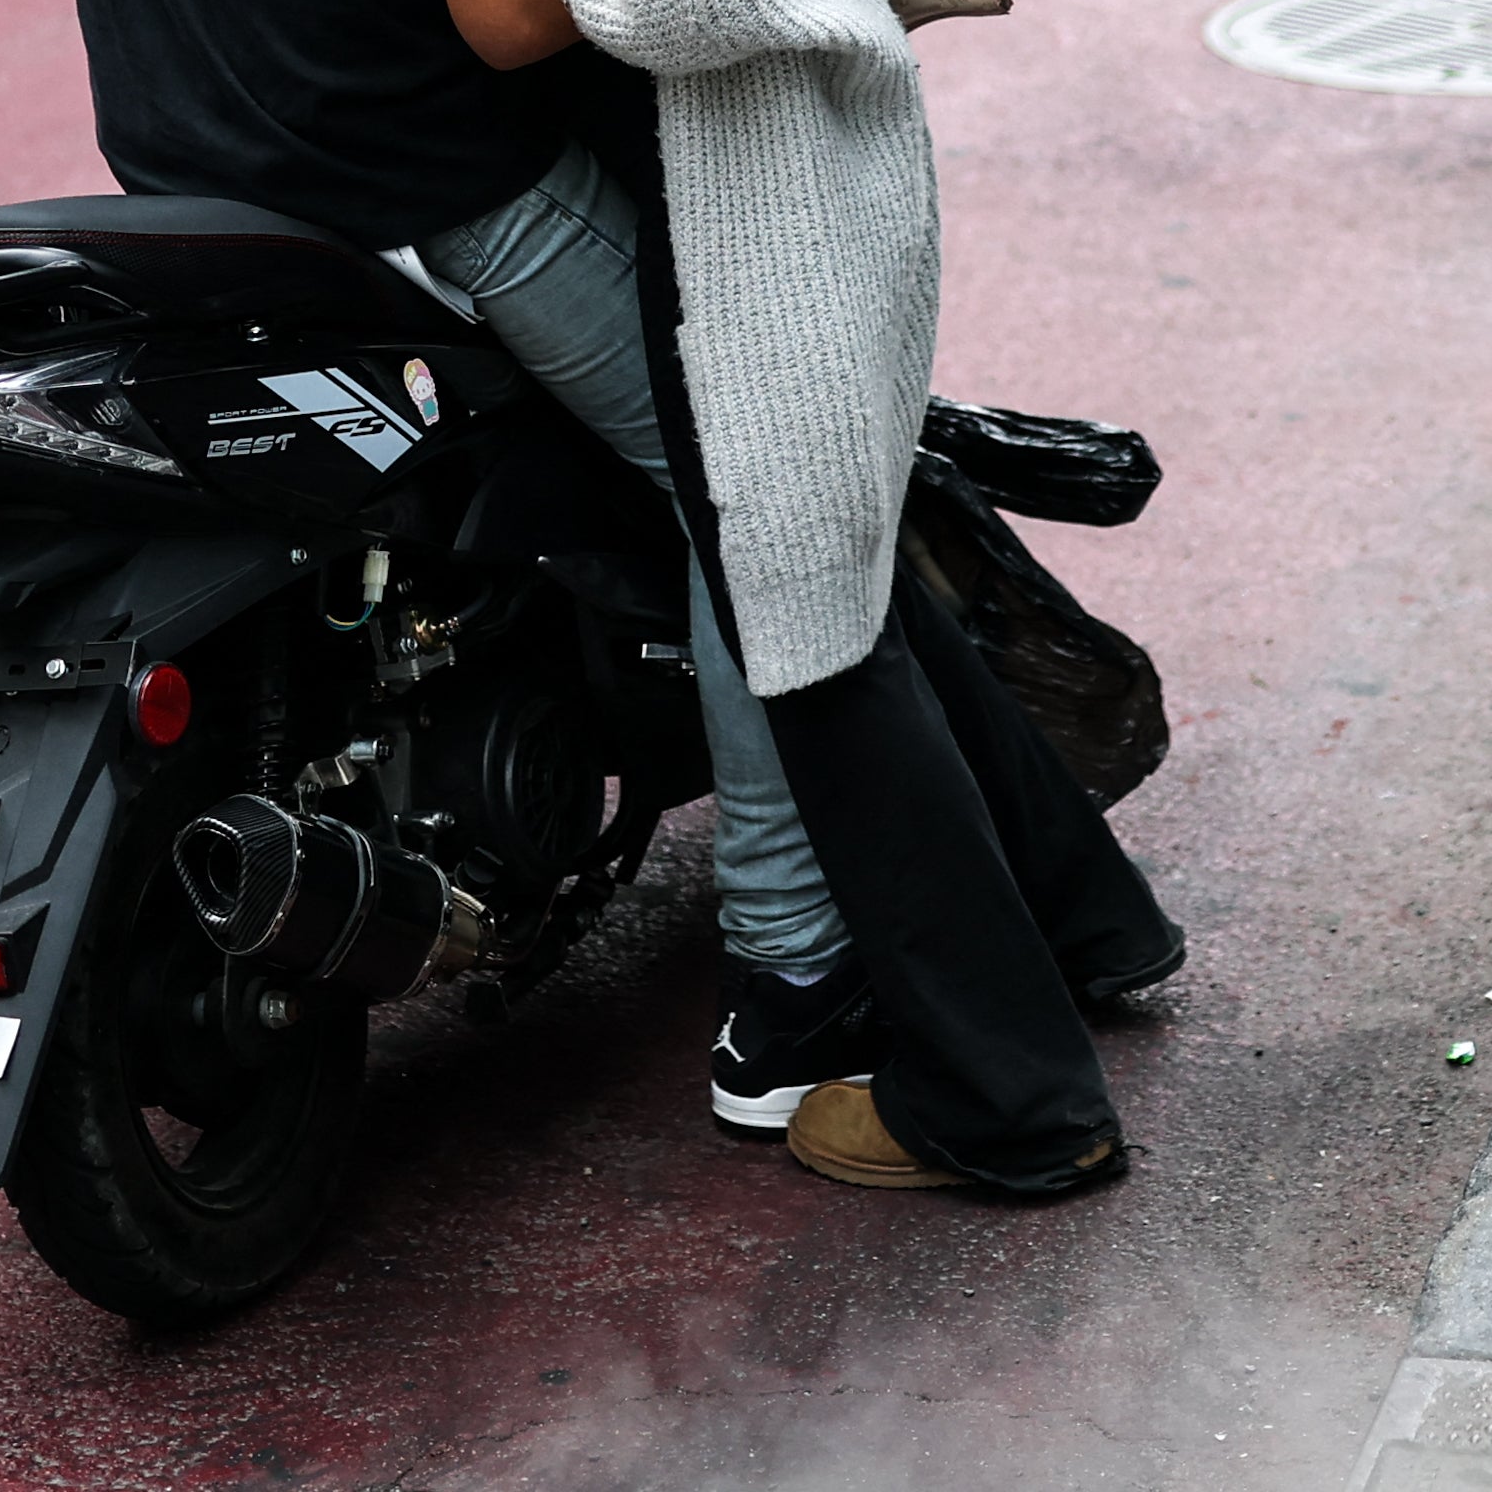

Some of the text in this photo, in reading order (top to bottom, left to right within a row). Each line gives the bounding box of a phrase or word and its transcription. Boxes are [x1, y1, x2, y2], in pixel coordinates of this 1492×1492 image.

[209, 406, 287, 419] SPORT POWER
[207, 433, 296, 458] BEST
